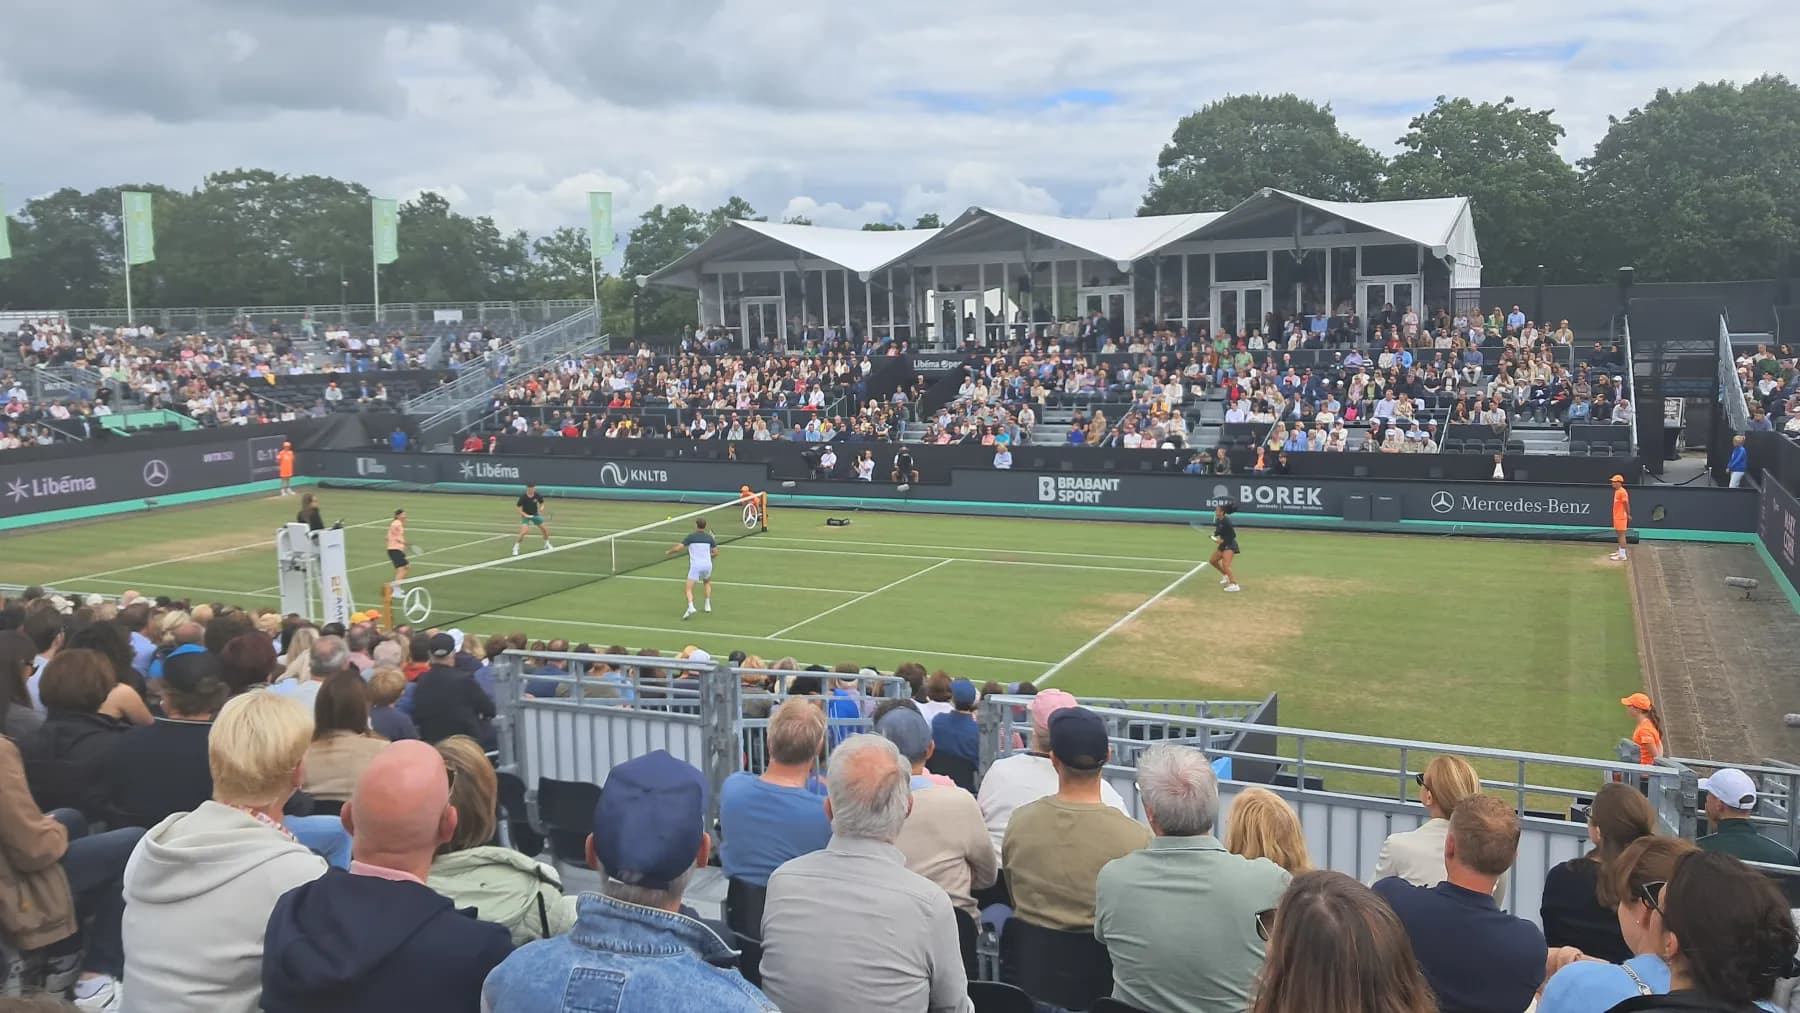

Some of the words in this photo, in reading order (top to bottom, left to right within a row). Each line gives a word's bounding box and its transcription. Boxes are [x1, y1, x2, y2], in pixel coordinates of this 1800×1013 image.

[913, 359, 940, 368] Libéma
[476, 463, 520, 479] Libéma
[630, 469, 668, 482] KNLTB
[32, 475, 96, 497] Libéma
[1057, 476, 1120, 491] BRABANT
[1058, 489, 1102, 503] SPORT
[1240, 485, 1323, 506] BOREK
[1461, 495, 1590, 514] Mercedes-Benz
